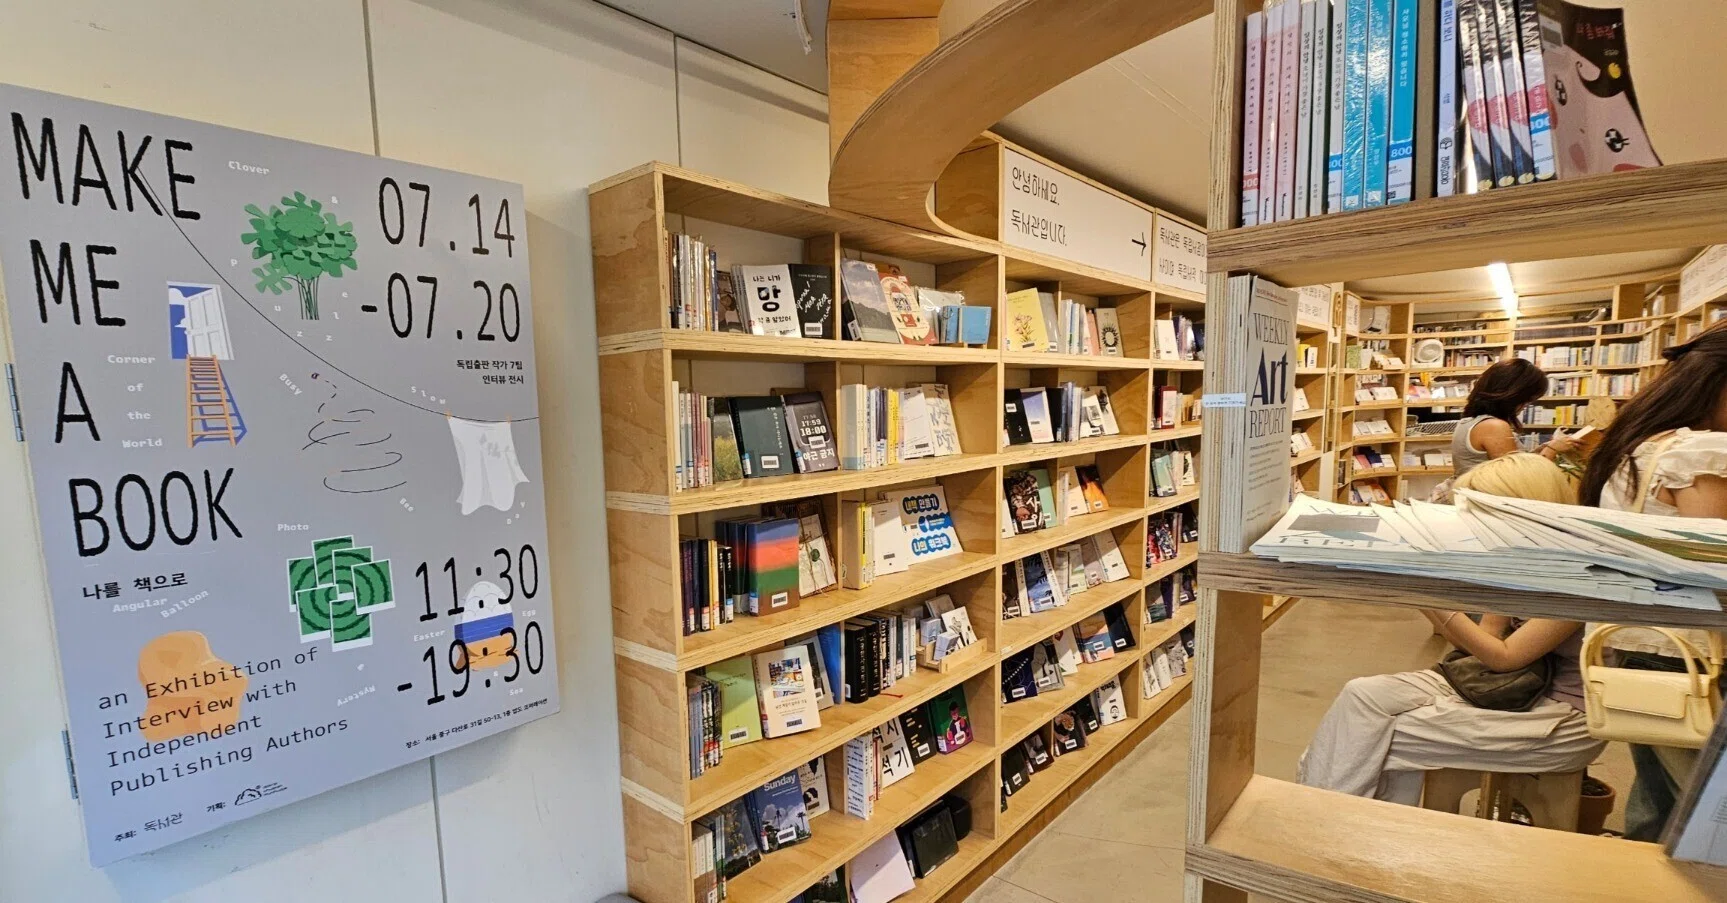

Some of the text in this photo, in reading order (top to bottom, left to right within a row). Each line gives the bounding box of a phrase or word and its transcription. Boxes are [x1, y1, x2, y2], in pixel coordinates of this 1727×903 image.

[1391, 146, 1412, 157] 800
[11, 112, 200, 220] MAKE
[228, 160, 270, 176] Clover
[1012, 166, 1060, 206] 안녕하세요.
[378, 177, 516, 258] 07.14
[1011, 209, 1067, 247] 독서관입니다.
[29, 239, 126, 327] ME
[361, 272, 520, 342] -07.20
[1253, 312, 1290, 345] WEEKLY
[107, 354, 156, 365] Corner
[456, 359, 489, 370] 독립출판
[492, 360, 508, 370] 작가
[127, 382, 144, 392] of
[279, 373, 302, 396] Busy
[482, 375, 524, 385] 인터뷰 전시
[1250, 347, 1289, 406] Art
[55, 362, 101, 443] A
[411, 386, 446, 405] Slow
[128, 410, 151, 420] the
[801, 418, 821, 427] 17:59
[1249, 407, 1287, 439] REPORT
[800, 425, 827, 436] 18:00
[122, 437, 163, 449] World
[803, 448, 835, 461] 야근 금지
[69, 467, 242, 557] BOOK
[400, 497, 414, 512] Bee
[277, 522, 309, 532] Photo
[82, 572, 188, 600] 나를 책으로
[415, 544, 538, 622] 11:30
[112, 597, 168, 613] Angular
[160, 589, 209, 618] Balloon
[413, 629, 446, 642] Easter
[397, 621, 543, 706] -19:30
[98, 646, 319, 709] an Exhibition of
[103, 679, 297, 739] Interview with
[107, 715, 262, 768] Independent
[406, 739, 420, 749] 장소:
[110, 719, 348, 796] Publishing Authors
[764, 774, 796, 792] Sunday
[144, 812, 183, 831] 독서관
